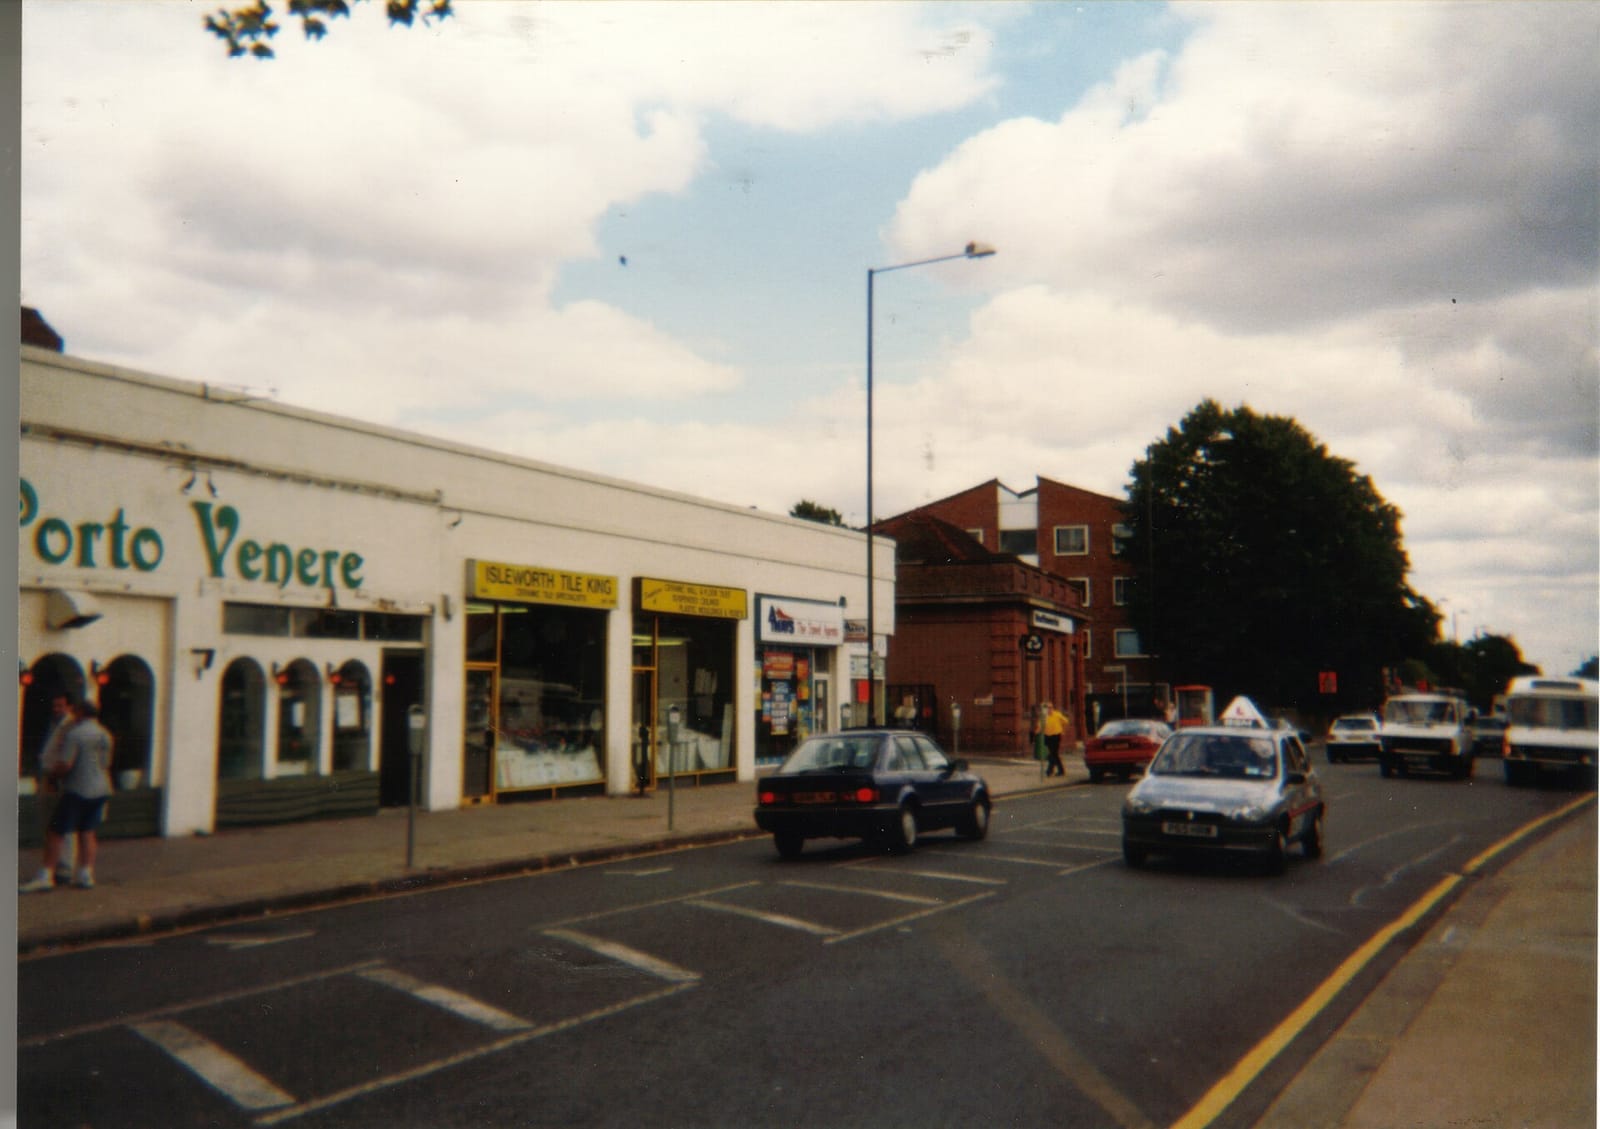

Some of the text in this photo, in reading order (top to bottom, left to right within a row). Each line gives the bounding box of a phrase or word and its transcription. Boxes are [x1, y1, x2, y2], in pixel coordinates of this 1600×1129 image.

[190, 500, 365, 590] Venere
[486, 565, 612, 595] ISLEWORTH TILE KING
